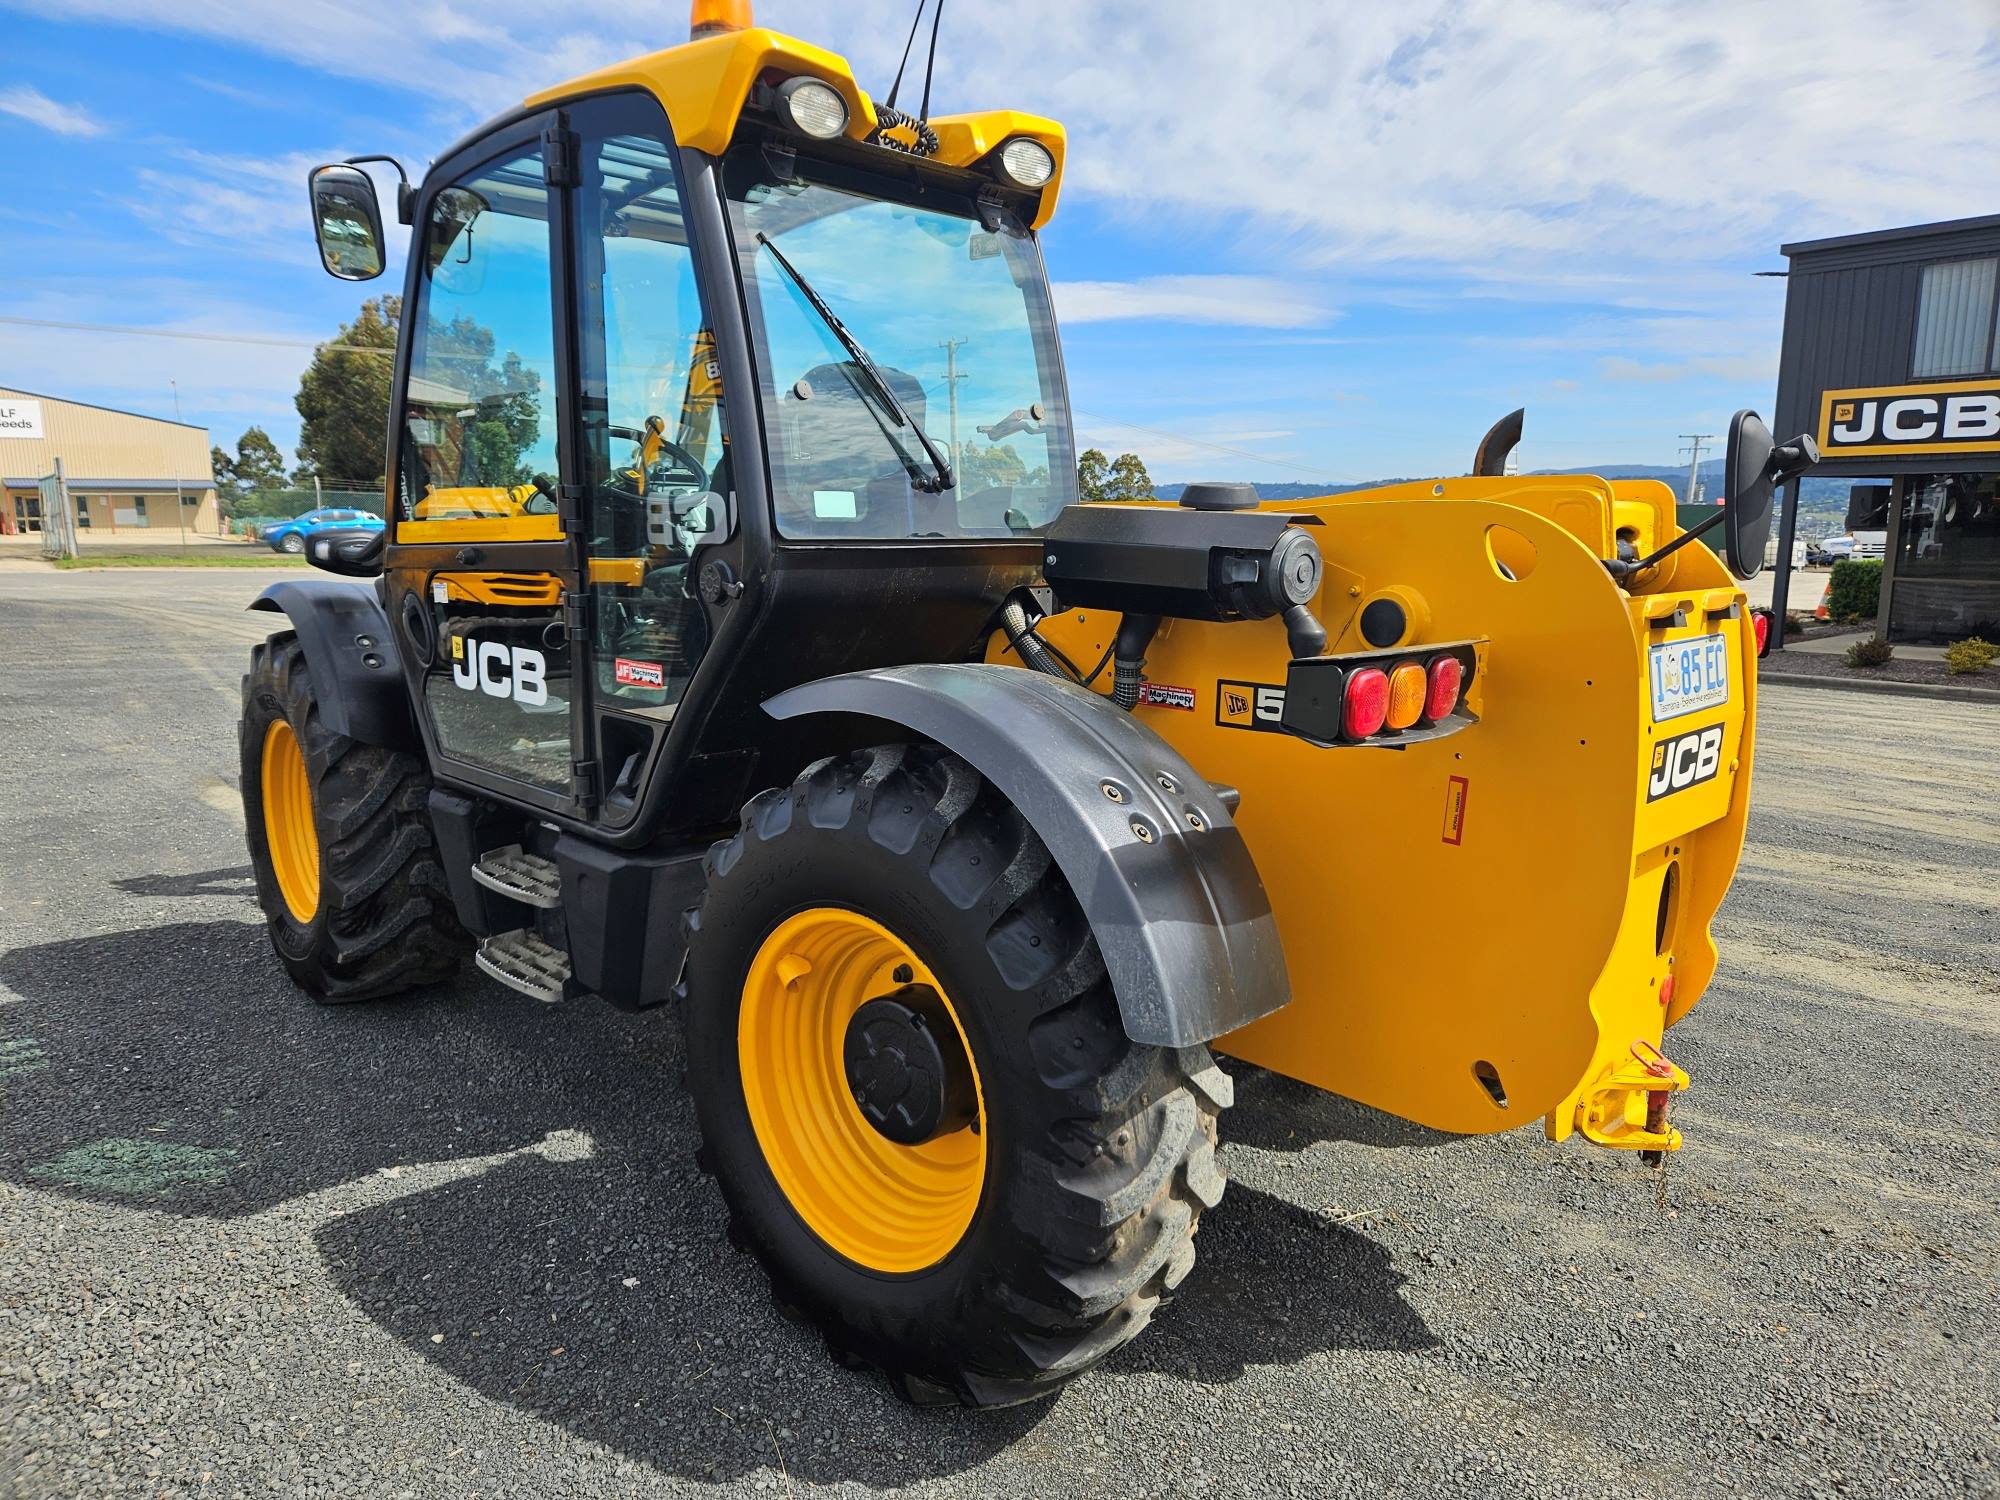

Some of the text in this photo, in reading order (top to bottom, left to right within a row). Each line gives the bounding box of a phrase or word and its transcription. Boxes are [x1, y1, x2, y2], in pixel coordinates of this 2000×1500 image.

[0, 419, 32, 428] eeds
[1833, 395, 2000, 443] JCB
[453, 639, 548, 707] JCB
[1655, 644, 1725, 702] I 85 EC
[1149, 690, 1193, 705] Machinery
[1229, 695, 1248, 713] JCB
[1256, 688, 1286, 722] 5
[1650, 728, 1722, 797] JCB
